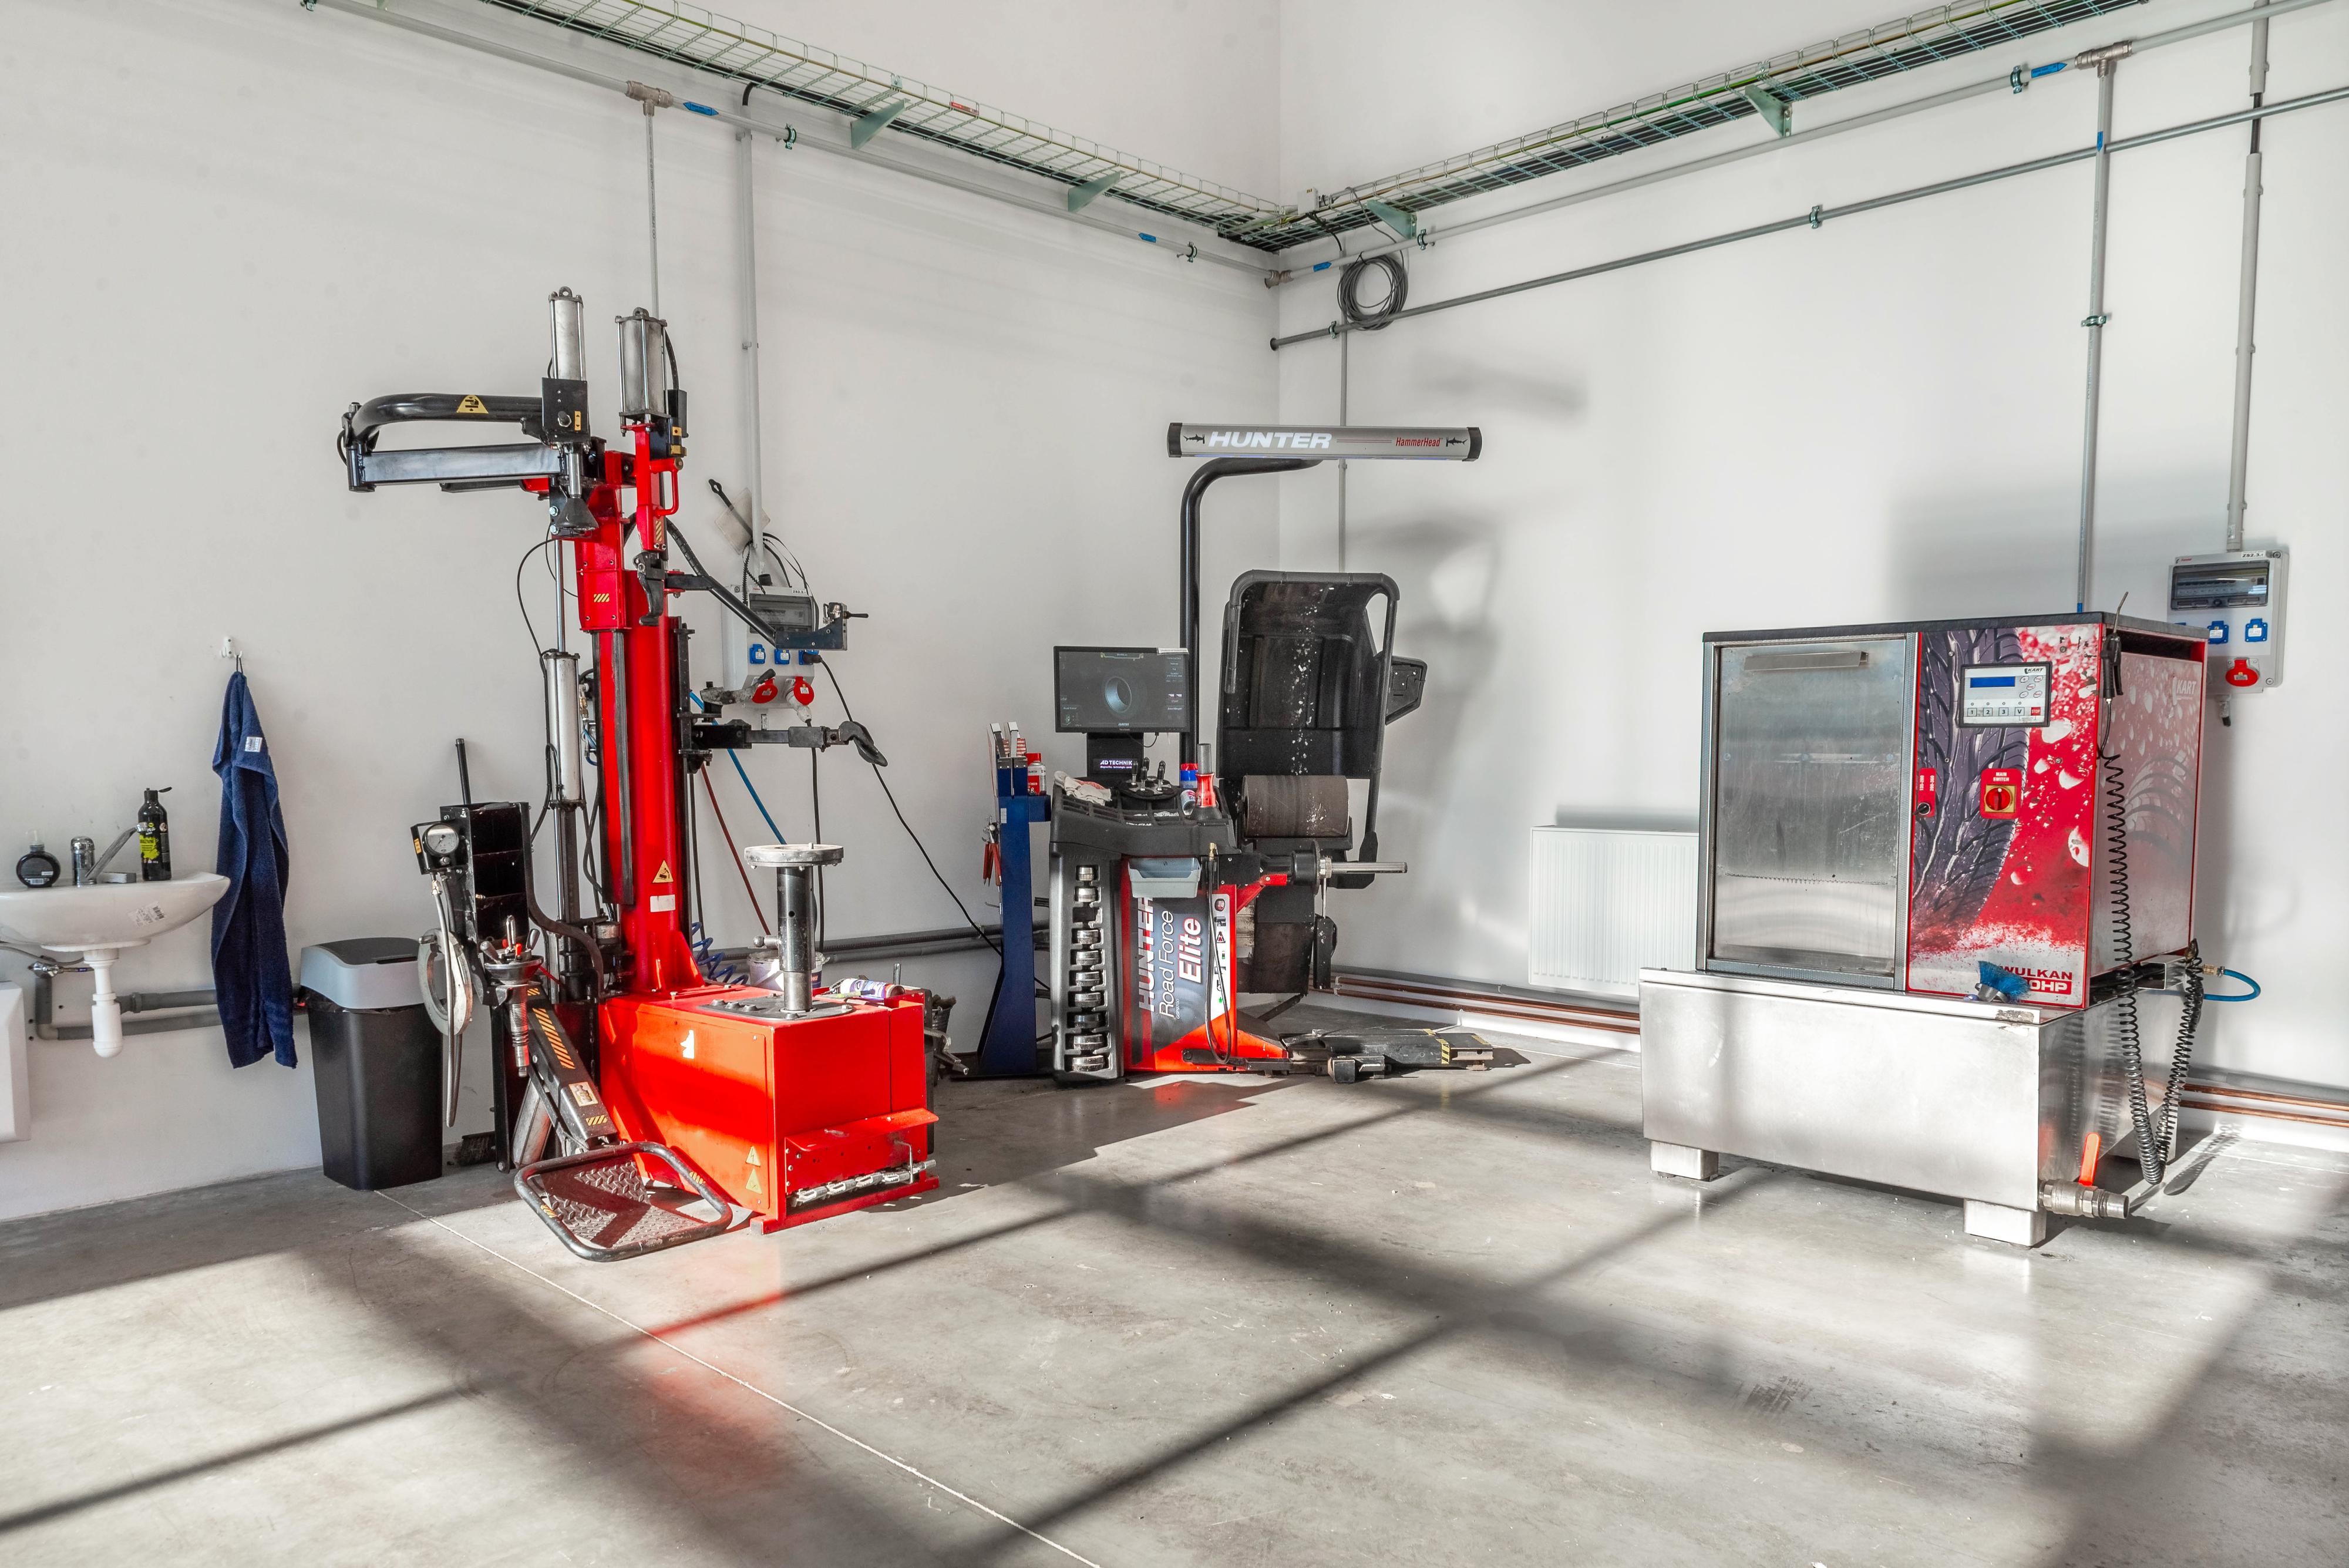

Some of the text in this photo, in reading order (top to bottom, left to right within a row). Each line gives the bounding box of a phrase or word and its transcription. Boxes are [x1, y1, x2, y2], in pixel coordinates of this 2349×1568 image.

[1209, 431, 1332, 449] HUNTER
[1395, 437, 1441, 447] HammerHead
[2176, 679, 2197, 695] KART
[1178, 917, 1202, 984] Elite
[1158, 910, 1175, 1018] Road Force
